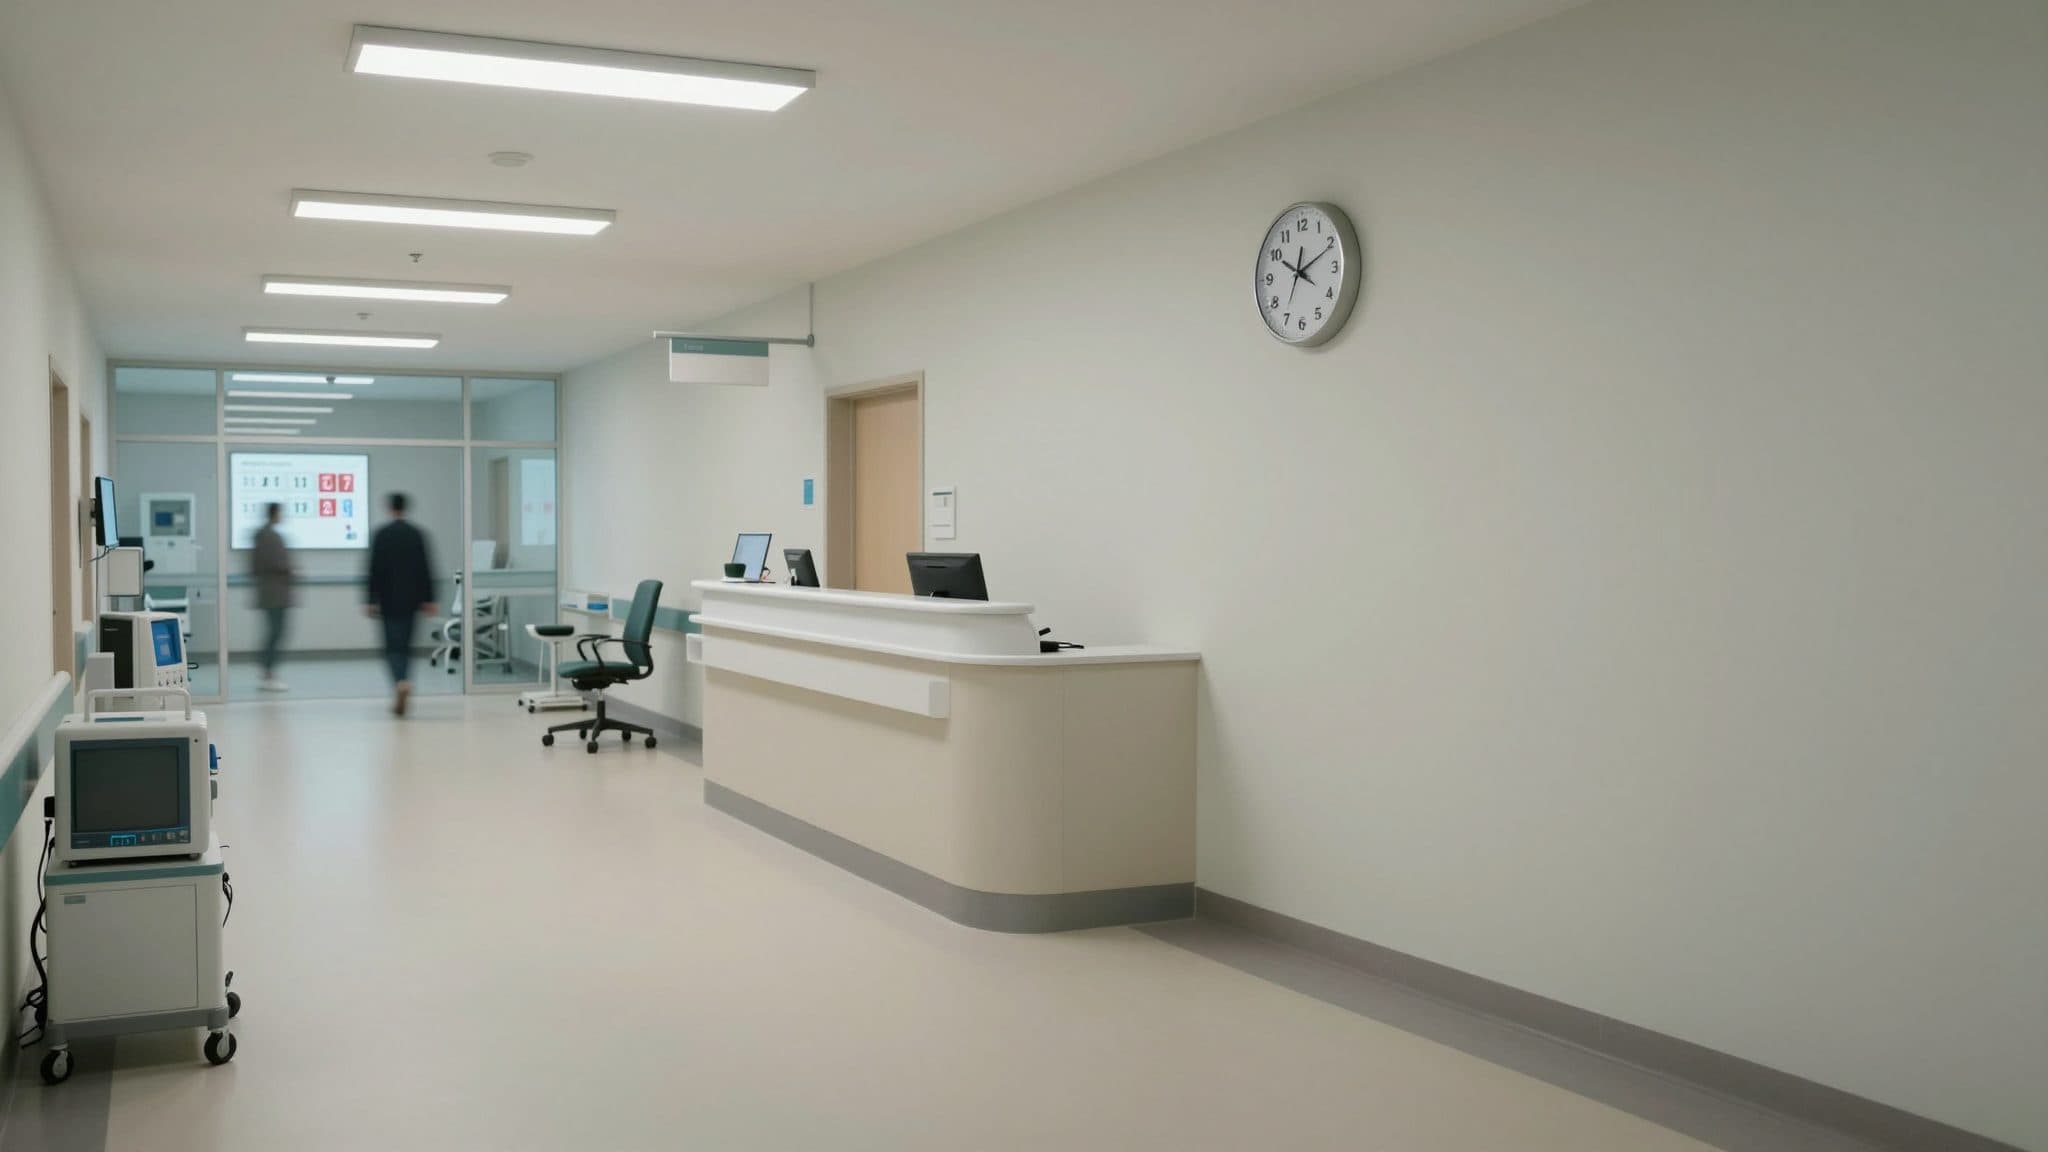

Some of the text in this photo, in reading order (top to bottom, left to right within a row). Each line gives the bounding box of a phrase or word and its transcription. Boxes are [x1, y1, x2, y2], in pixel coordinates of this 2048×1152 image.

[1297, 218, 1308, 232] 12
[1317, 220, 1321, 234] 1
[1281, 229, 1290, 243] 11
[1326, 236, 1335, 249] 2
[1270, 248, 1282, 261] 10
[1331, 261, 1338, 274] 3
[1265, 273, 1274, 286] 9
[1325, 286, 1333, 300] 4
[1270, 296, 1279, 309] 8
[1283, 312, 1290, 326] 7
[1314, 307, 1322, 320] 5
[1298, 317, 1306, 331] 6
